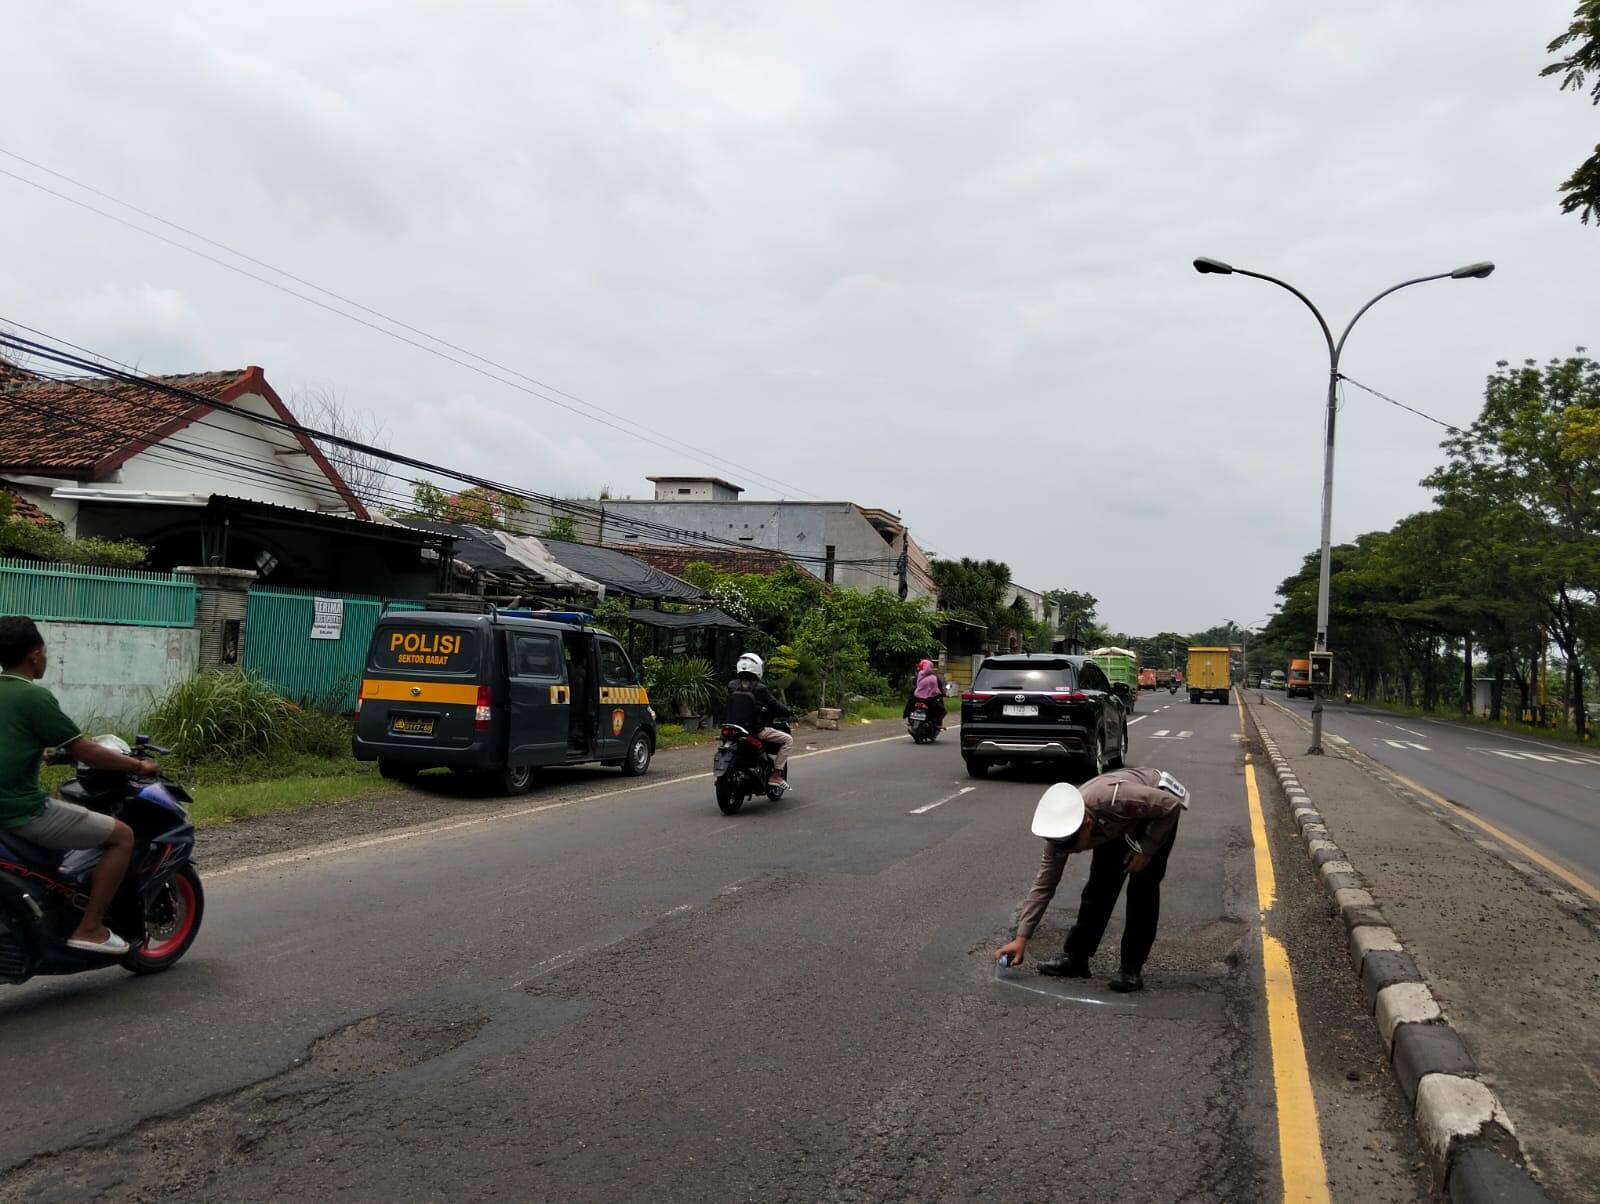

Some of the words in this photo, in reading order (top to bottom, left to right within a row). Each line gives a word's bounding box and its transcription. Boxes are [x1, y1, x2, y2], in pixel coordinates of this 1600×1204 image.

[391, 633, 461, 654] POLISI
[398, 654, 425, 664] SEKTOR
[425, 655, 449, 665] BABAT
